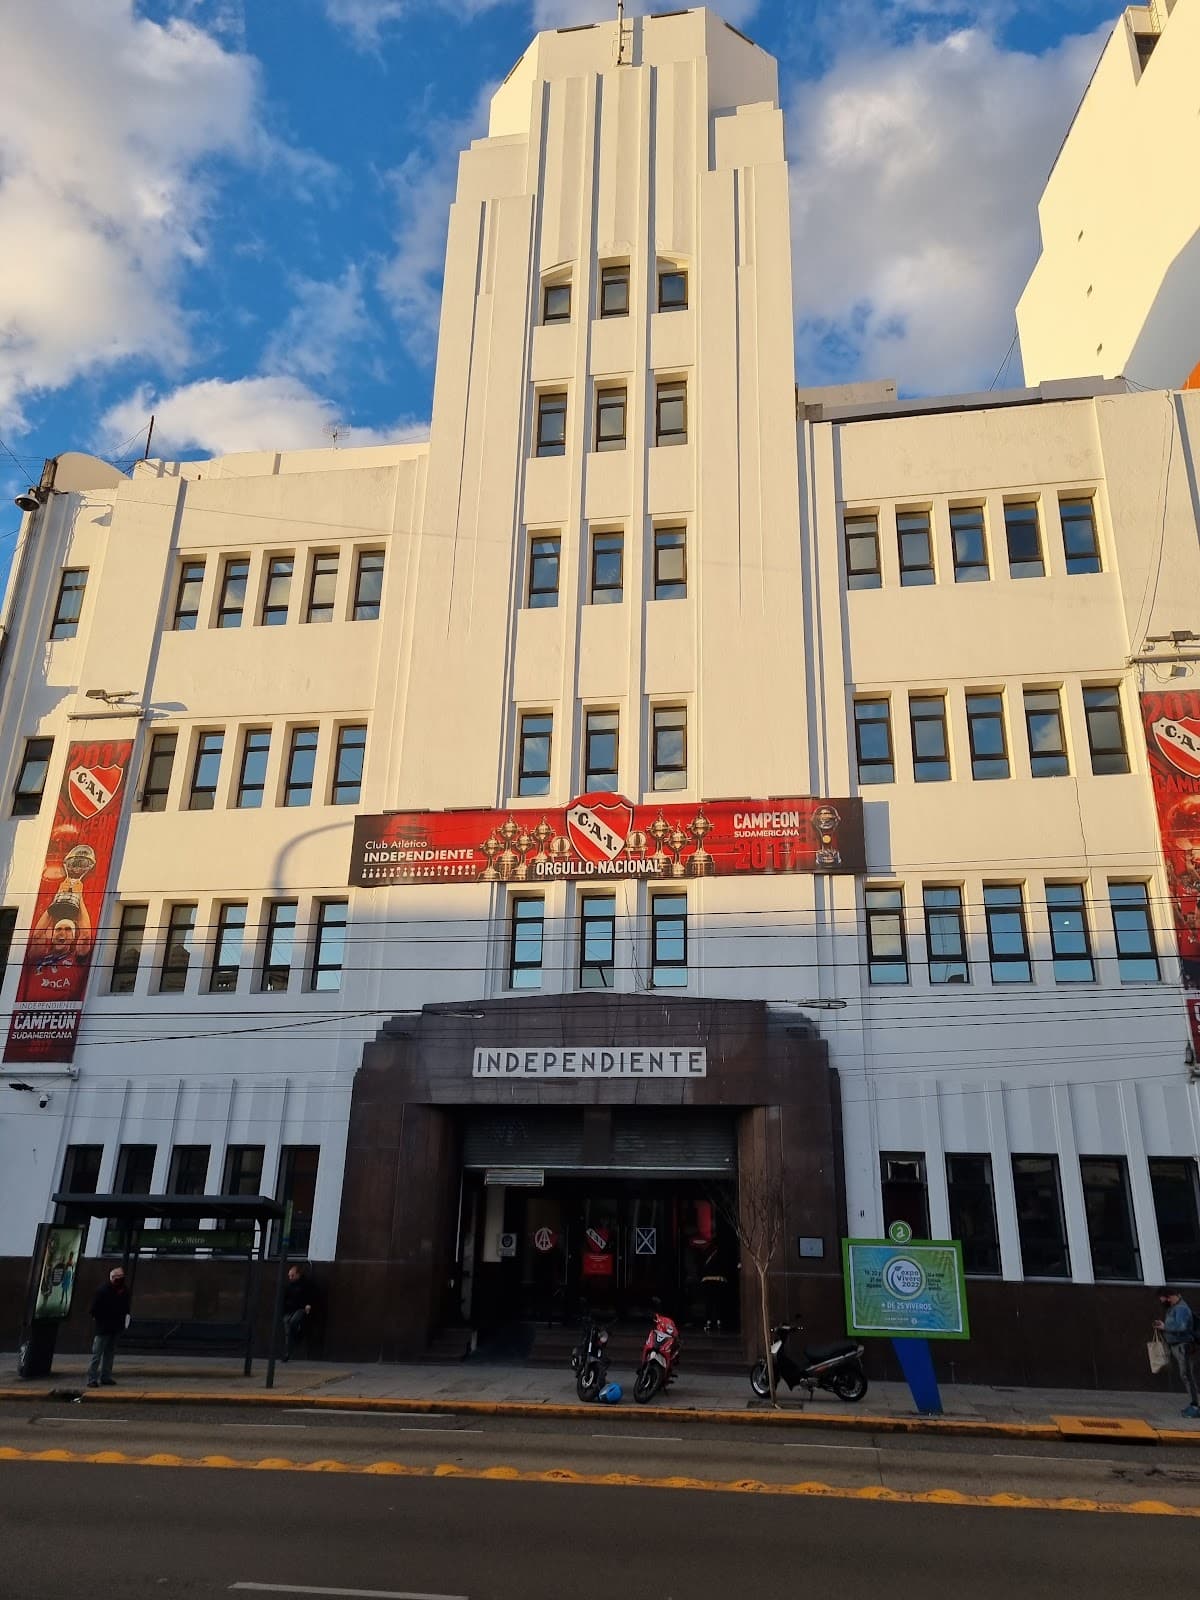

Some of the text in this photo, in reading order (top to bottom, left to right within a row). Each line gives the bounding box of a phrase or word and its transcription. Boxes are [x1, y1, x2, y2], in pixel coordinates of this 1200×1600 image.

[733, 811, 800, 830] CAMPEON
[733, 829, 800, 838] SUDAMERICANA
[365, 839, 428, 850] Club Atlético
[364, 849, 474, 863] INDEPENDIENTE
[734, 839, 797, 869] 2017
[536, 858, 662, 876] ORGULLO NACIONAL
[14, 1011, 77, 1030] CAMPEON
[11, 1031, 73, 1040] SUDAMERICANA
[477, 1052, 703, 1073] INDEPENDIENTE
